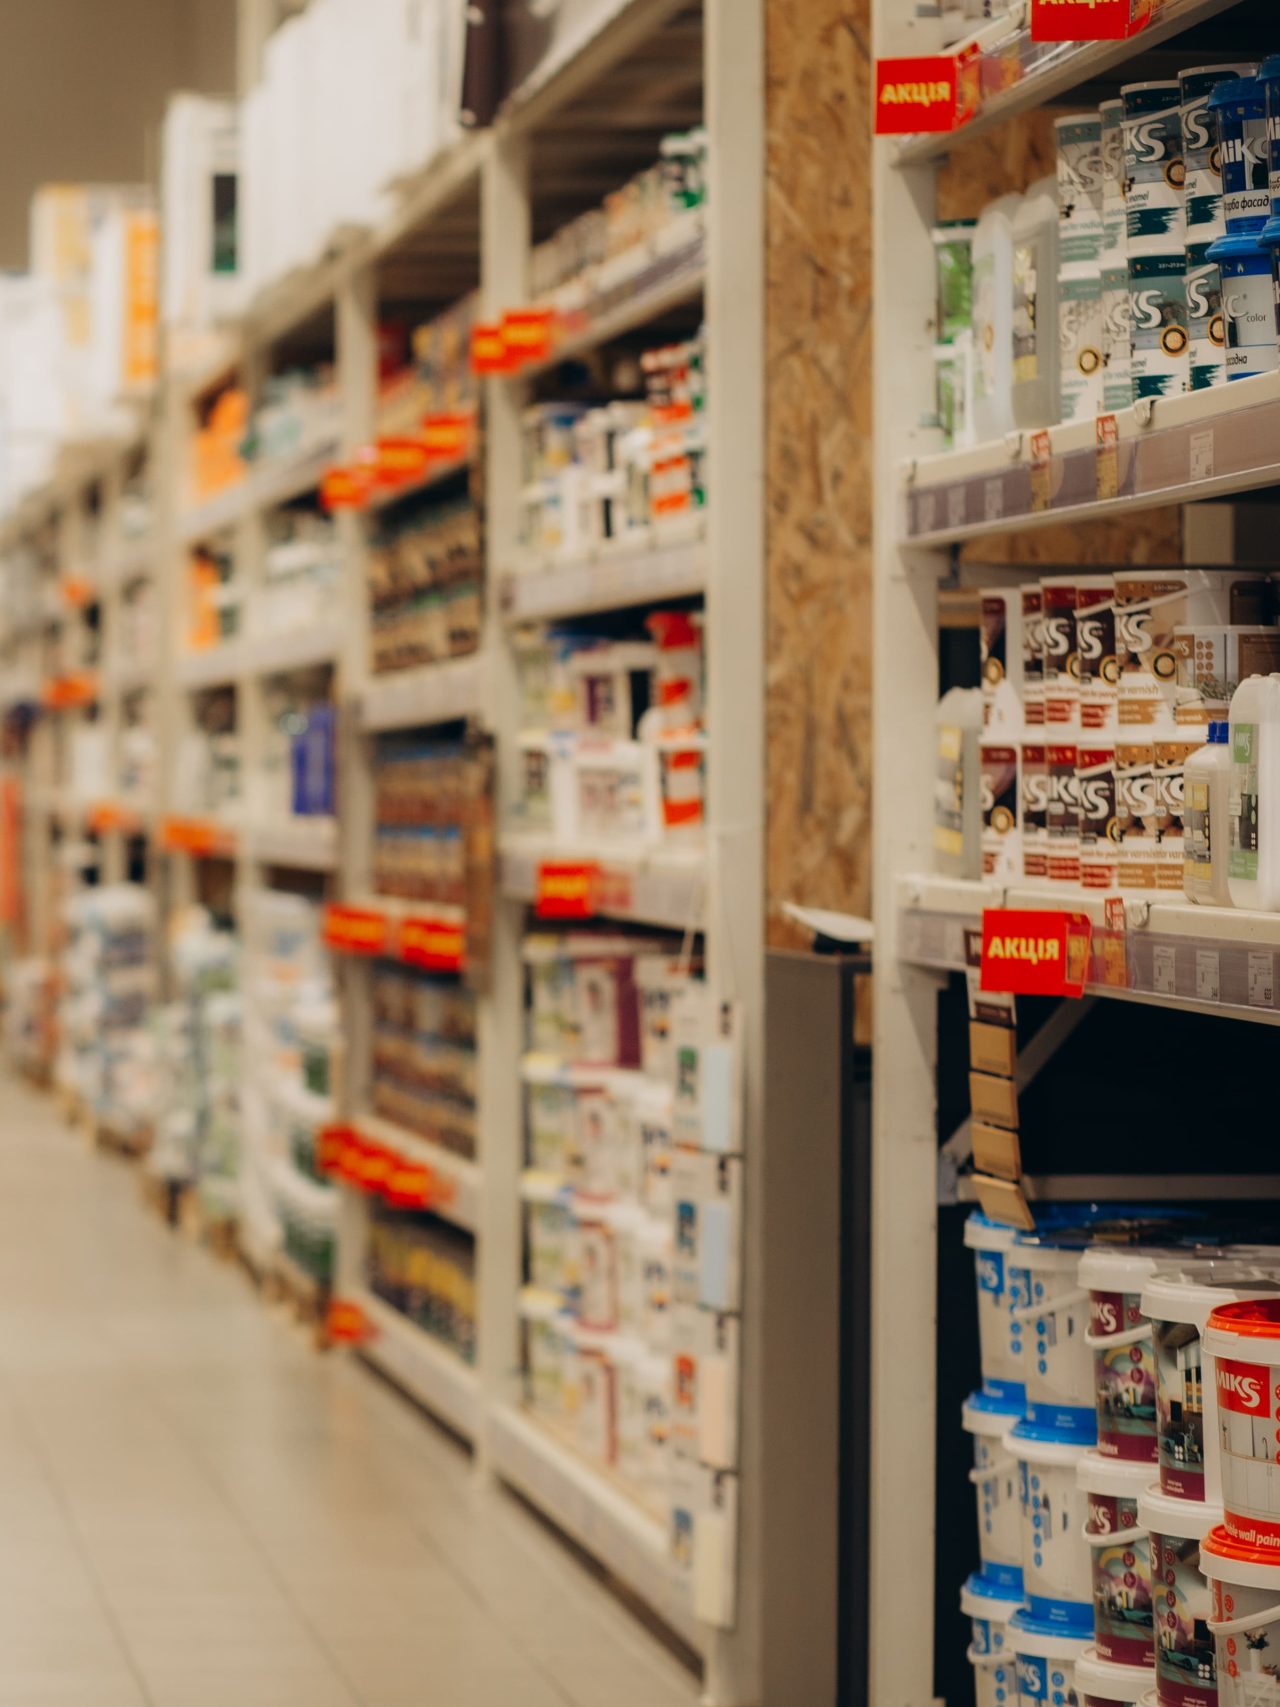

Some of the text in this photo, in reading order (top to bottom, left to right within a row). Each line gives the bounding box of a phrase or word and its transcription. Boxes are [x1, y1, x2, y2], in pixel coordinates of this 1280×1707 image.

[880, 81, 950, 107] АКЦІЯ
[1246, 313, 1267, 323] color
[988, 936, 1060, 965] АКЦІЯ
[1239, 1529, 1256, 1543] wall
[1256, 1533, 1280, 1548] pain
